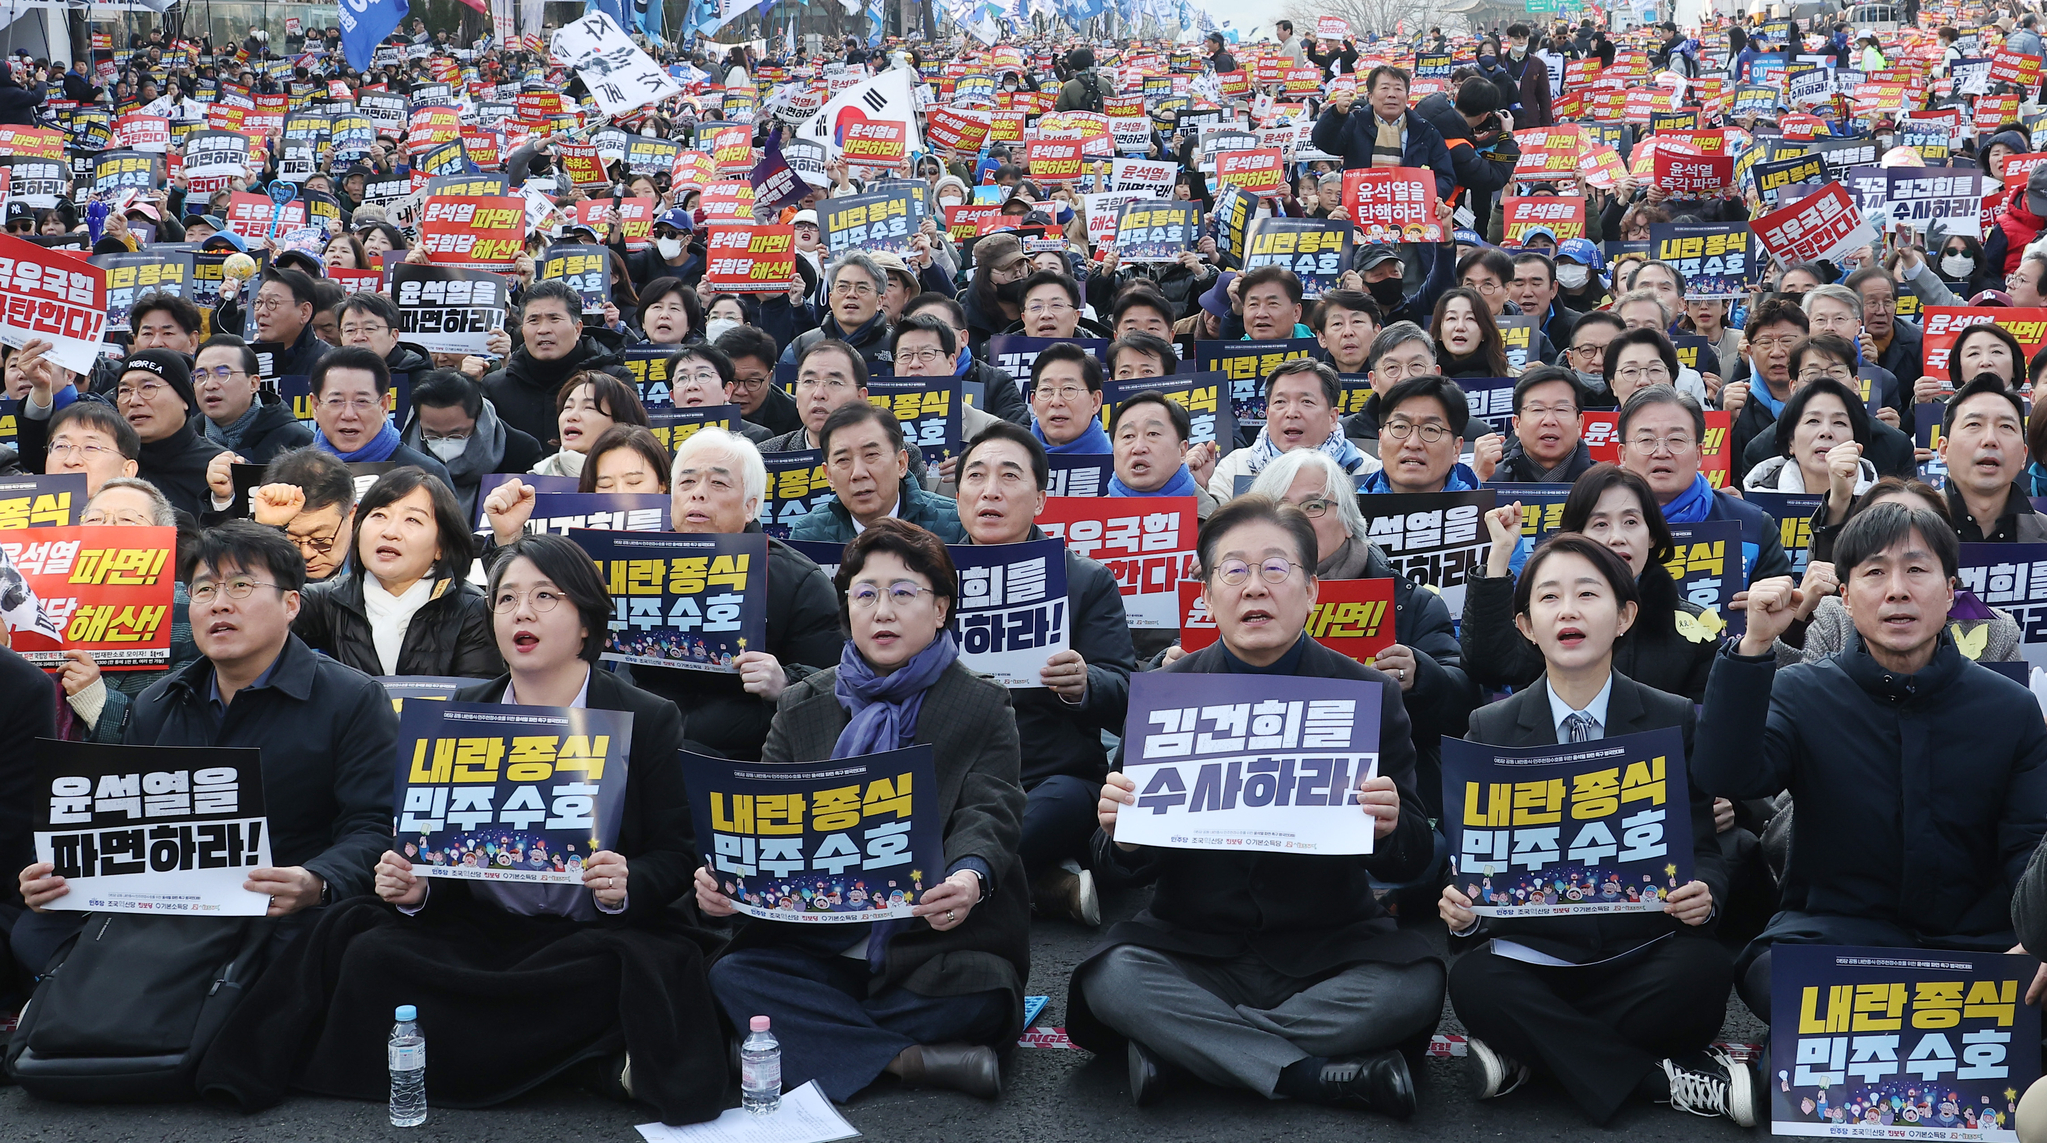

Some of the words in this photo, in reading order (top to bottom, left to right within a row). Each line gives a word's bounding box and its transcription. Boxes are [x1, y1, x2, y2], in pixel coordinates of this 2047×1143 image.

[1418, 57, 1436, 67] 내란
[1994, 53, 2023, 66] 윤석열
[517, 96, 541, 107] 윤석열
[538, 95, 560, 107] 파면!
[1738, 89, 1756, 101] 내란
[1756, 90, 1776, 101] 종식
[1791, 81, 1829, 100] 수사하라!
[361, 96, 405, 109] 윤석열을
[1107, 105, 1138, 116] 구속취소
[1755, 101, 1775, 111] 수호
[121, 119, 166, 134] 극우국힘
[350, 117, 371, 130] 종식
[429, 112, 457, 127] 파면!
[505, 121, 530, 134] 윤석열
[529, 121, 551, 135] 파면!
[934, 112, 968, 131] 윤석열
[960, 124, 987, 138] 파면!
[1113, 121, 1145, 134] 윤석열을
[1180, 112, 1220, 127] 윤석열을
[1783, 123, 1813, 136] 윤석열
[120, 131, 169, 147] 규탄한다!
[848, 123, 899, 140] 윤석열을
[931, 126, 962, 144] 국힘당
[955, 138, 981, 152] 해산!
[1513, 132, 1549, 147] 윤석열
[1544, 134, 1577, 149] 파면!
[186, 136, 246, 154] 윤석열을
[631, 142, 654, 155] 내란
[653, 145, 678, 157] 종식
[843, 138, 904, 158] 파면하라!
[1030, 144, 1076, 159] 윤석열을
[1205, 136, 1257, 152] 윤석열을
[96, 160, 121, 180] 내란
[121, 157, 152, 174] 종식
[187, 149, 249, 167] 파면하라!
[1029, 159, 1081, 176] 파면하라!
[1224, 155, 1276, 173] 윤석열을
[1545, 155, 1578, 170] 해산!
[120, 172, 151, 188] 수호
[1121, 165, 1171, 182] 윤석열을
[1219, 171, 1283, 189] 파면하라!
[1669, 162, 1714, 179] 윤석열
[1760, 172, 1790, 192] 내란
[1789, 161, 1821, 184] 종식
[364, 180, 412, 196] 윤석열을
[702, 184, 741, 197] 윤석열
[1357, 181, 1425, 205] 윤석열을
[1660, 177, 1690, 192] 즉각
[1692, 176, 1721, 190] 파면
[1893, 176, 1974, 199] 김건희를
[10, 203, 22, 214] NY
[424, 202, 476, 222] 윤석열
[470, 207, 523, 230] 파면!
[664, 210, 675, 220] LA
[702, 202, 739, 215] 국힘당
[828, 210, 867, 233] 내란
[869, 198, 907, 222] 종식
[1358, 203, 1427, 226] 탄핵하라
[1514, 203, 1577, 220] 윤석열을
[1892, 198, 1980, 221] 수사하라!
[1118, 211, 1151, 232] 내란
[1151, 209, 1186, 227] 종식
[1765, 192, 1839, 248] 극우국힘
[425, 233, 477, 254] 국힘당
[709, 232, 752, 249] 윤석열
[748, 234, 790, 254] 파면!
[829, 228, 868, 253] 민주
[869, 216, 908, 240] 수호
[1116, 229, 1149, 249] 민주
[1148, 225, 1185, 245] 수호
[1254, 232, 1295, 255] 내란
[1297, 231, 1344, 254] 종식
[1659, 237, 1704, 262] 내란
[1704, 232, 1748, 258] 종식
[566, 254, 603, 274] 종식
[708, 258, 752, 275] 국힘당
[750, 261, 794, 279] 해산!
[1703, 253, 1746, 279] 수호
[144, 263, 185, 288] 종식
[399, 280, 497, 306] 윤석열을
[400, 308, 503, 334] 파면하라!
[128, 359, 163, 376] KOREA
[1210, 354, 1258, 380] 내란
[893, 390, 951, 421] 종식
[1368, 504, 1479, 553] 석열을
[68, 548, 170, 587] 파면!
[594, 559, 666, 596] 내란
[668, 554, 750, 595] 종식
[668, 592, 744, 632] 수호
[66, 604, 168, 643] 해산!
[1142, 699, 1357, 760] 김건희를
[408, 736, 505, 784] 내란
[507, 734, 611, 783] 종식
[50, 767, 238, 824] 윤석열을
[1138, 756, 1373, 816] 수사하라!
[1463, 778, 1566, 827] 내란
[1571, 756, 1666, 820] 종식
[399, 786, 495, 832] 민주
[499, 782, 602, 831] 수호
[710, 791, 806, 835] 내란
[812, 772, 913, 832] 종식
[51, 821, 262, 879] 파면하라!
[713, 832, 805, 878] 민주
[811, 820, 913, 875] 수호
[1460, 826, 1560, 873] 민주
[1568, 808, 1667, 866] 수호
[1798, 983, 1908, 1035] 내란
[1911, 980, 2018, 1029] 종식
[1793, 1034, 1900, 1087] 민주
[1905, 1029, 2011, 1082] 수호
